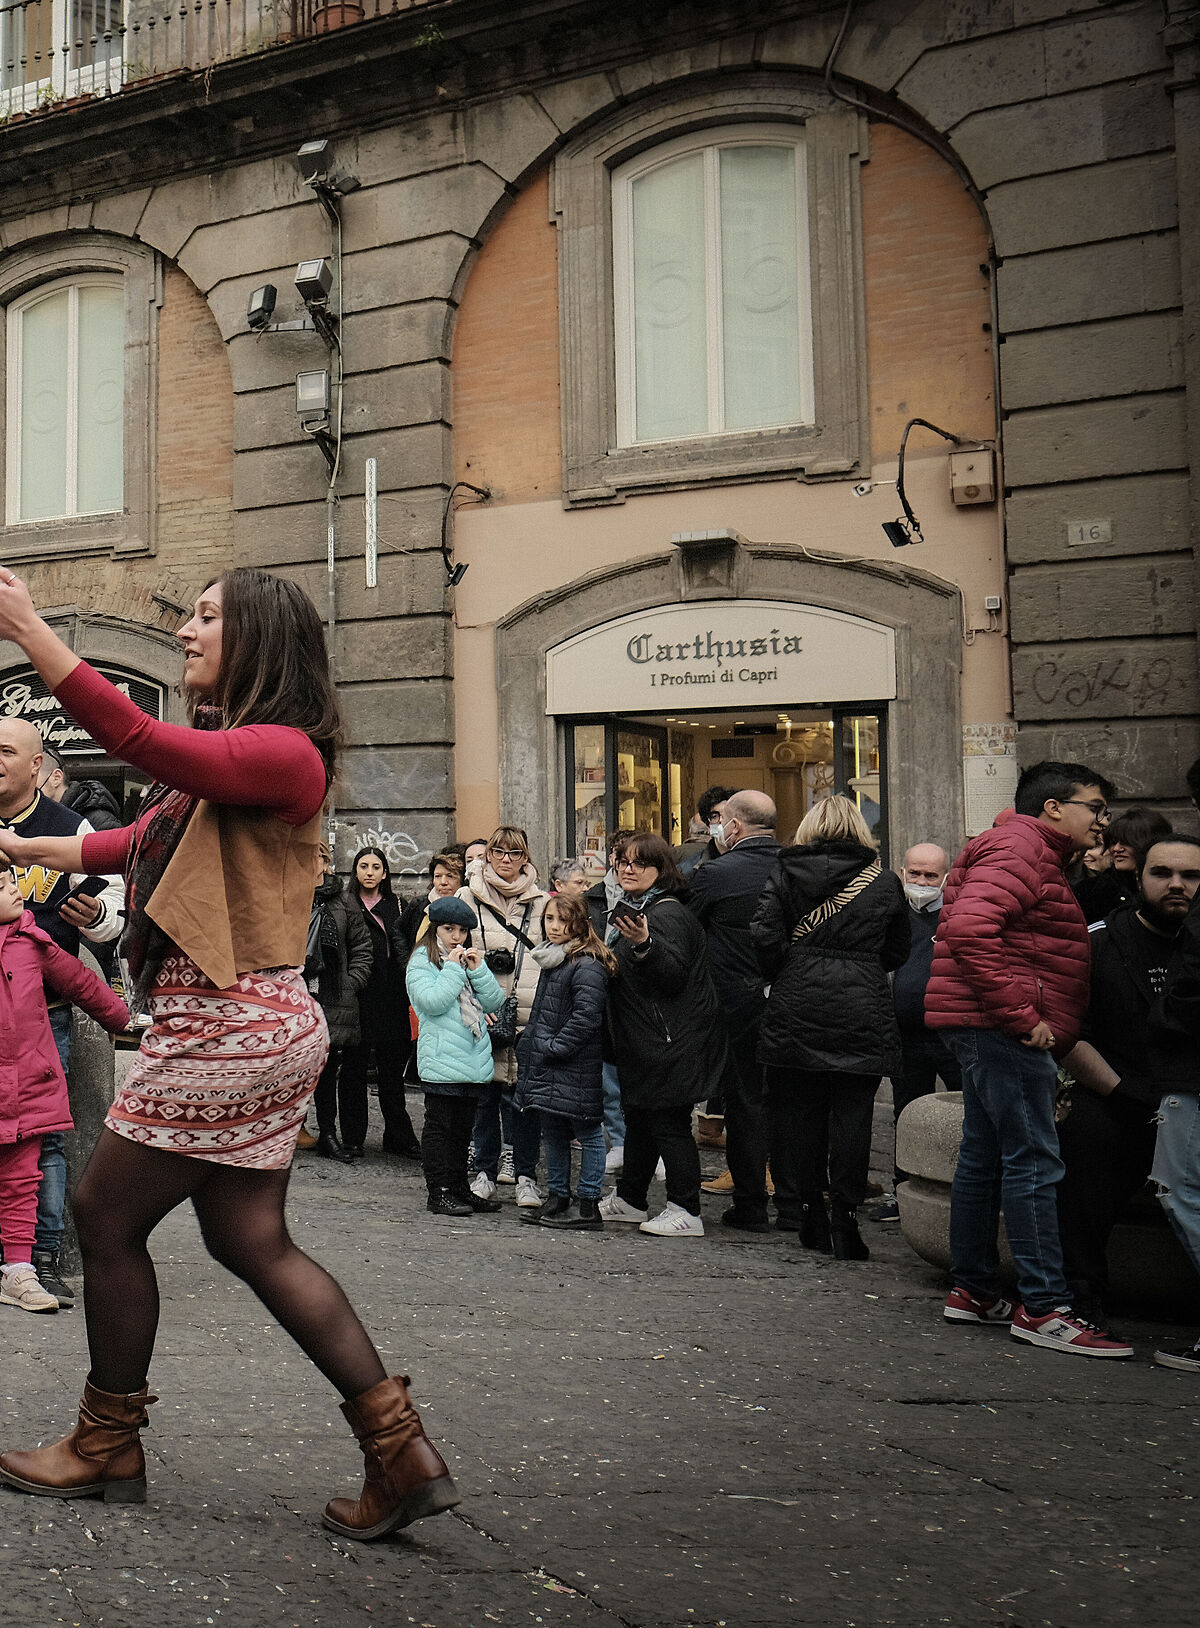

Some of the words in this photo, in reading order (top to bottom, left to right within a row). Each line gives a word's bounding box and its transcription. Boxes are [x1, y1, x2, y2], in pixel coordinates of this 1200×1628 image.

[1078, 525, 1101, 542] 16
[626, 628, 803, 668] Carthusia
[650, 673, 656, 686] I
[660, 670, 716, 686] Profumi
[720, 669, 734, 683] di
[738, 667, 778, 685] Capri
